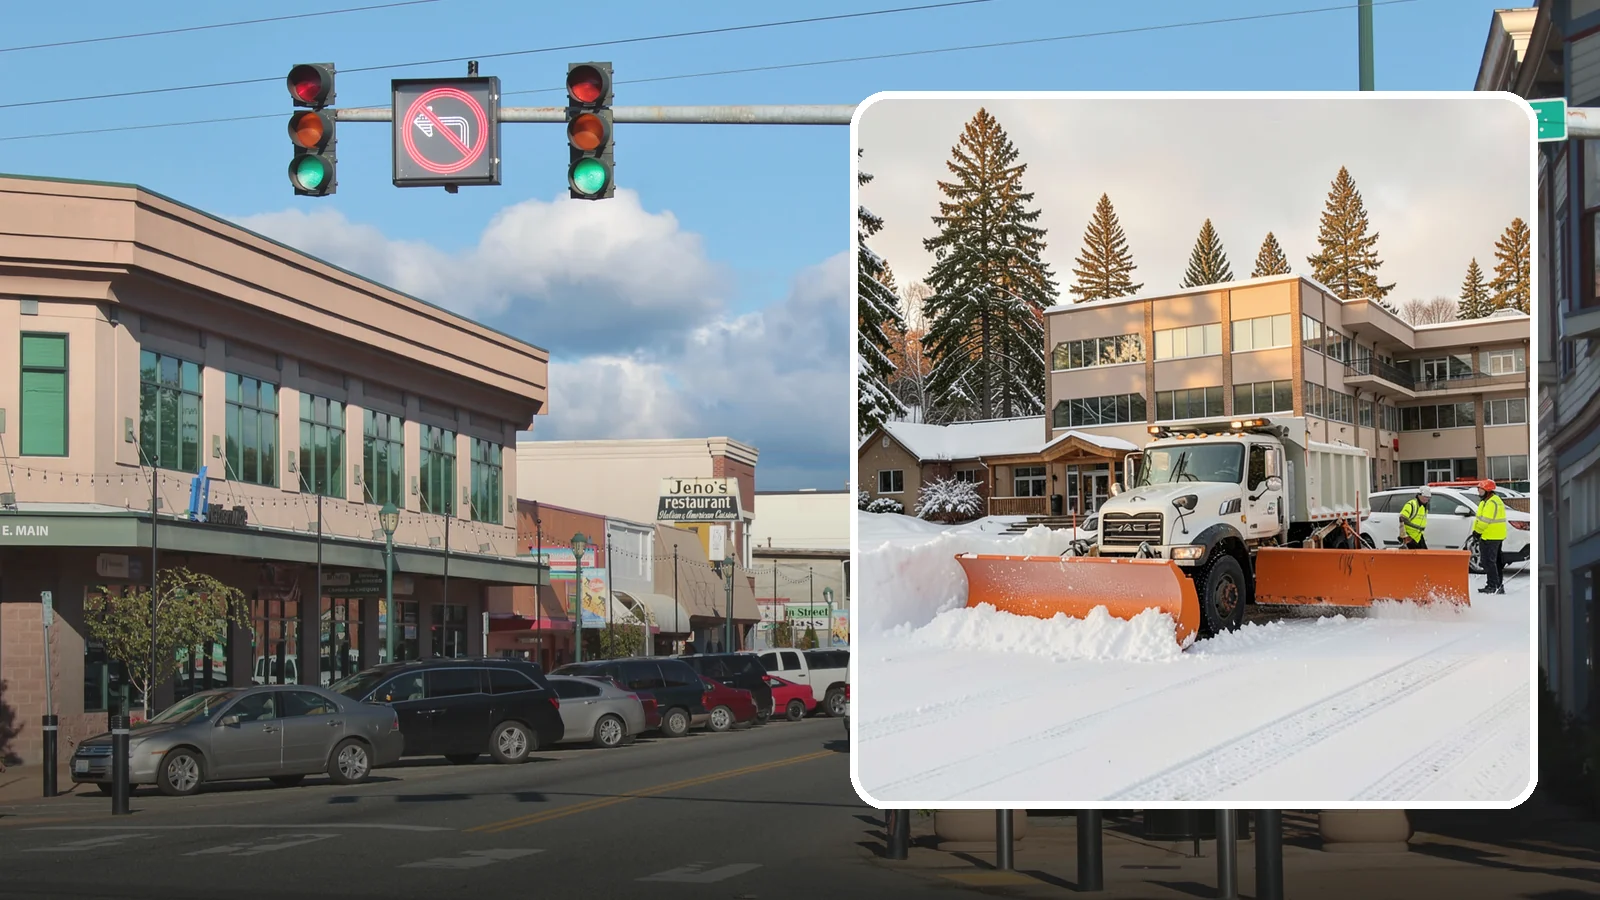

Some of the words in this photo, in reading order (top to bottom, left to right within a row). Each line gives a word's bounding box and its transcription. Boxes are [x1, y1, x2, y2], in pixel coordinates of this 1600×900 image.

[670, 480, 727, 494] Jeno's
[665, 496, 731, 508] restaurant
[658, 510, 681, 519] Italian
[686, 510, 714, 519] American
[714, 510, 737, 519] Cuisine
[2, 525, 13, 536] E.
[15, 525, 49, 536] MAIN
[797, 607, 828, 616] Street
